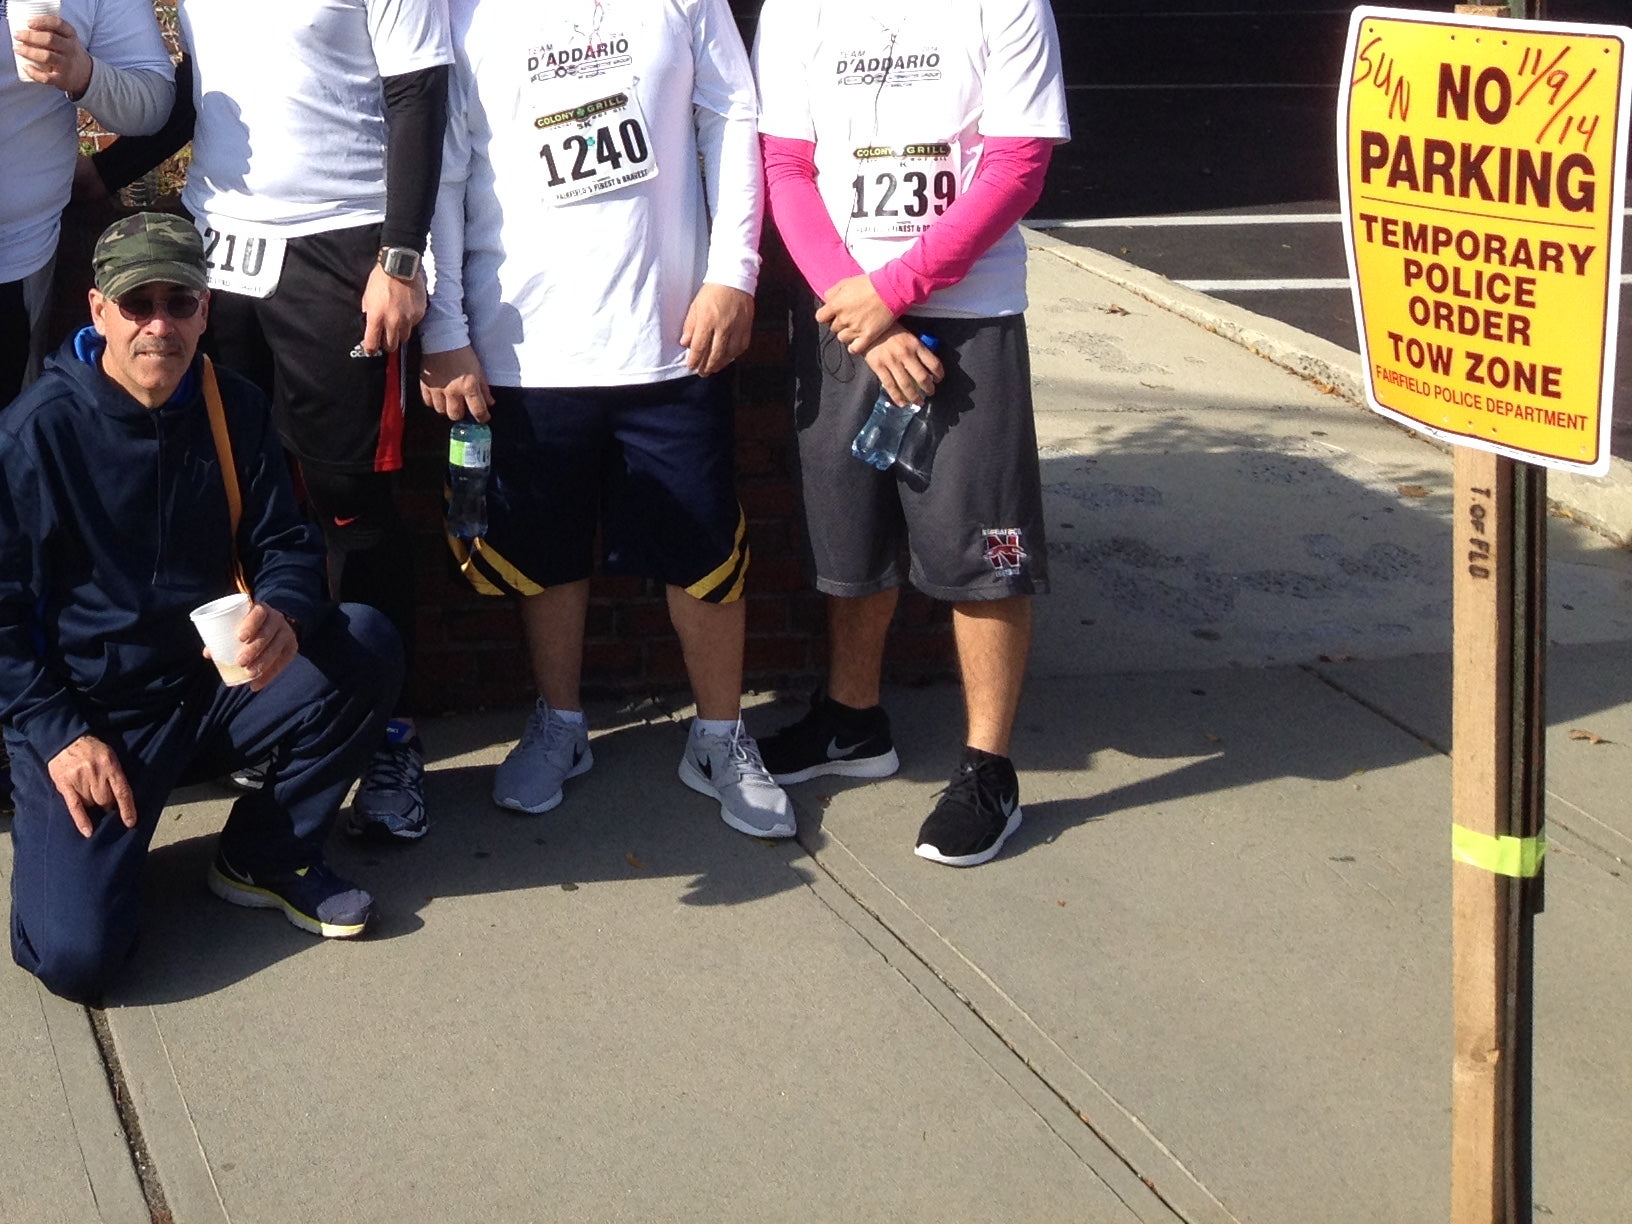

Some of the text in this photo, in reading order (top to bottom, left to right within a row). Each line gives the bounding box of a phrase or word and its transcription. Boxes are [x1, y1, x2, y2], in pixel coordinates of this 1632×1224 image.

[527, 38, 629, 72] D'ADDARIO
[836, 53, 941, 75] D'ADDARIO
[1352, 37, 1411, 123] SUN
[537, 96, 625, 127] COLONY GRILL
[1436, 61, 1513, 126] NO
[576, 120, 592, 130] 5K
[906, 146, 946, 155] GRILL
[539, 118, 649, 188] 1240
[1360, 129, 1597, 214] PARKING
[851, 170, 956, 218] 1239
[1359, 212, 1597, 277] TEMPORARY
[1403, 257, 1537, 309] POLICE
[1408, 295, 1532, 347] ORDER
[1387, 330, 1564, 400] TOW ZONE
[1375, 364, 1590, 432] FAIRFIELD POLICE DEPARTMENT
